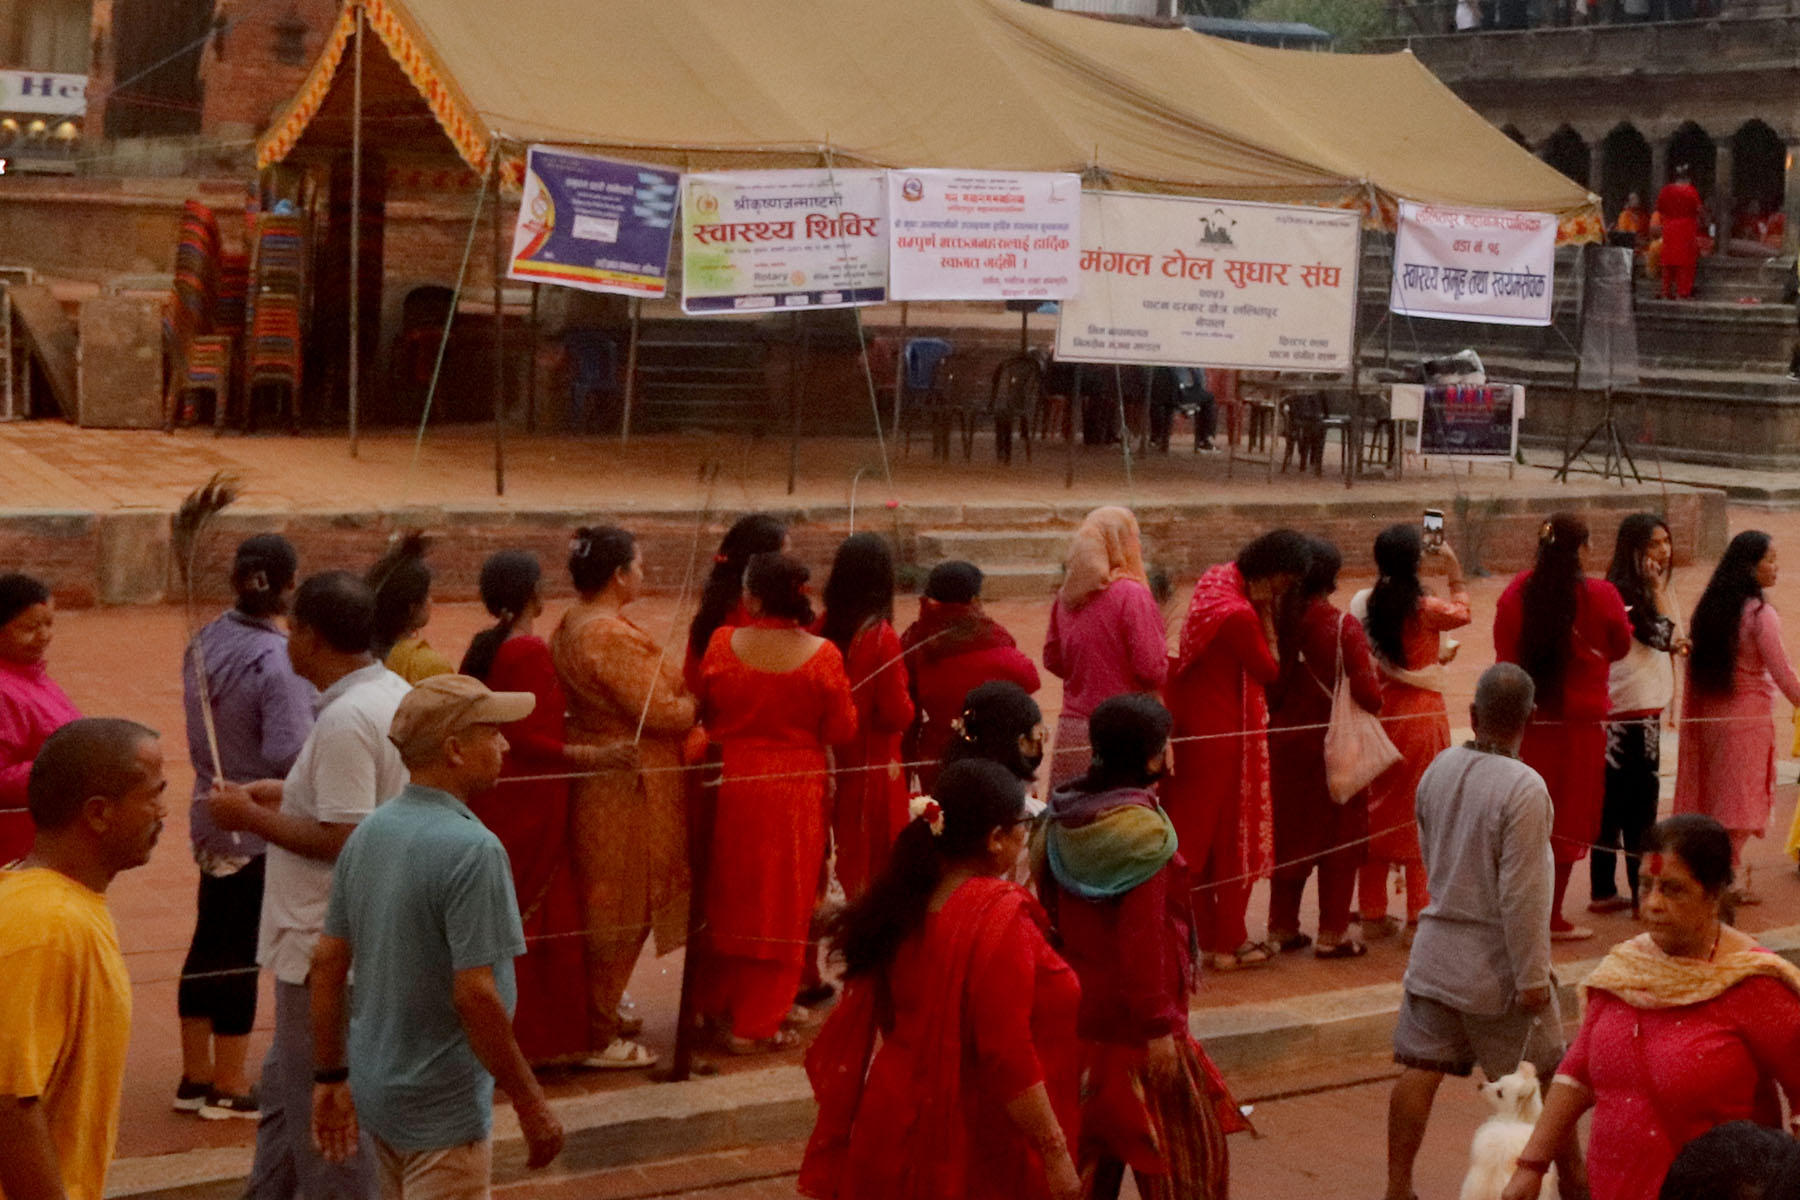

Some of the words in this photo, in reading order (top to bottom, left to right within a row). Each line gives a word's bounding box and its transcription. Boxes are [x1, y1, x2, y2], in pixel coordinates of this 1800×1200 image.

[693, 220, 795, 244] स्वास्थ्य
[805, 211, 880, 240] शिविर
[897, 233, 936, 253] सम्पूर्ण
[1033, 234, 1070, 251] हार्दिक
[1452, 239, 1471, 253] वडा
[941, 256, 980, 269] स्वागत
[1080, 246, 1153, 276] मंगल
[1161, 249, 1214, 280] टोल
[1224, 259, 1292, 288] सुधार
[1300, 261, 1342, 288] संघ
[753, 271, 790, 283] Rotary
[1403, 263, 1438, 291] स्वास्थ्य
[1441, 266, 1468, 300] समूह
[1469, 269, 1489, 294] तथा
